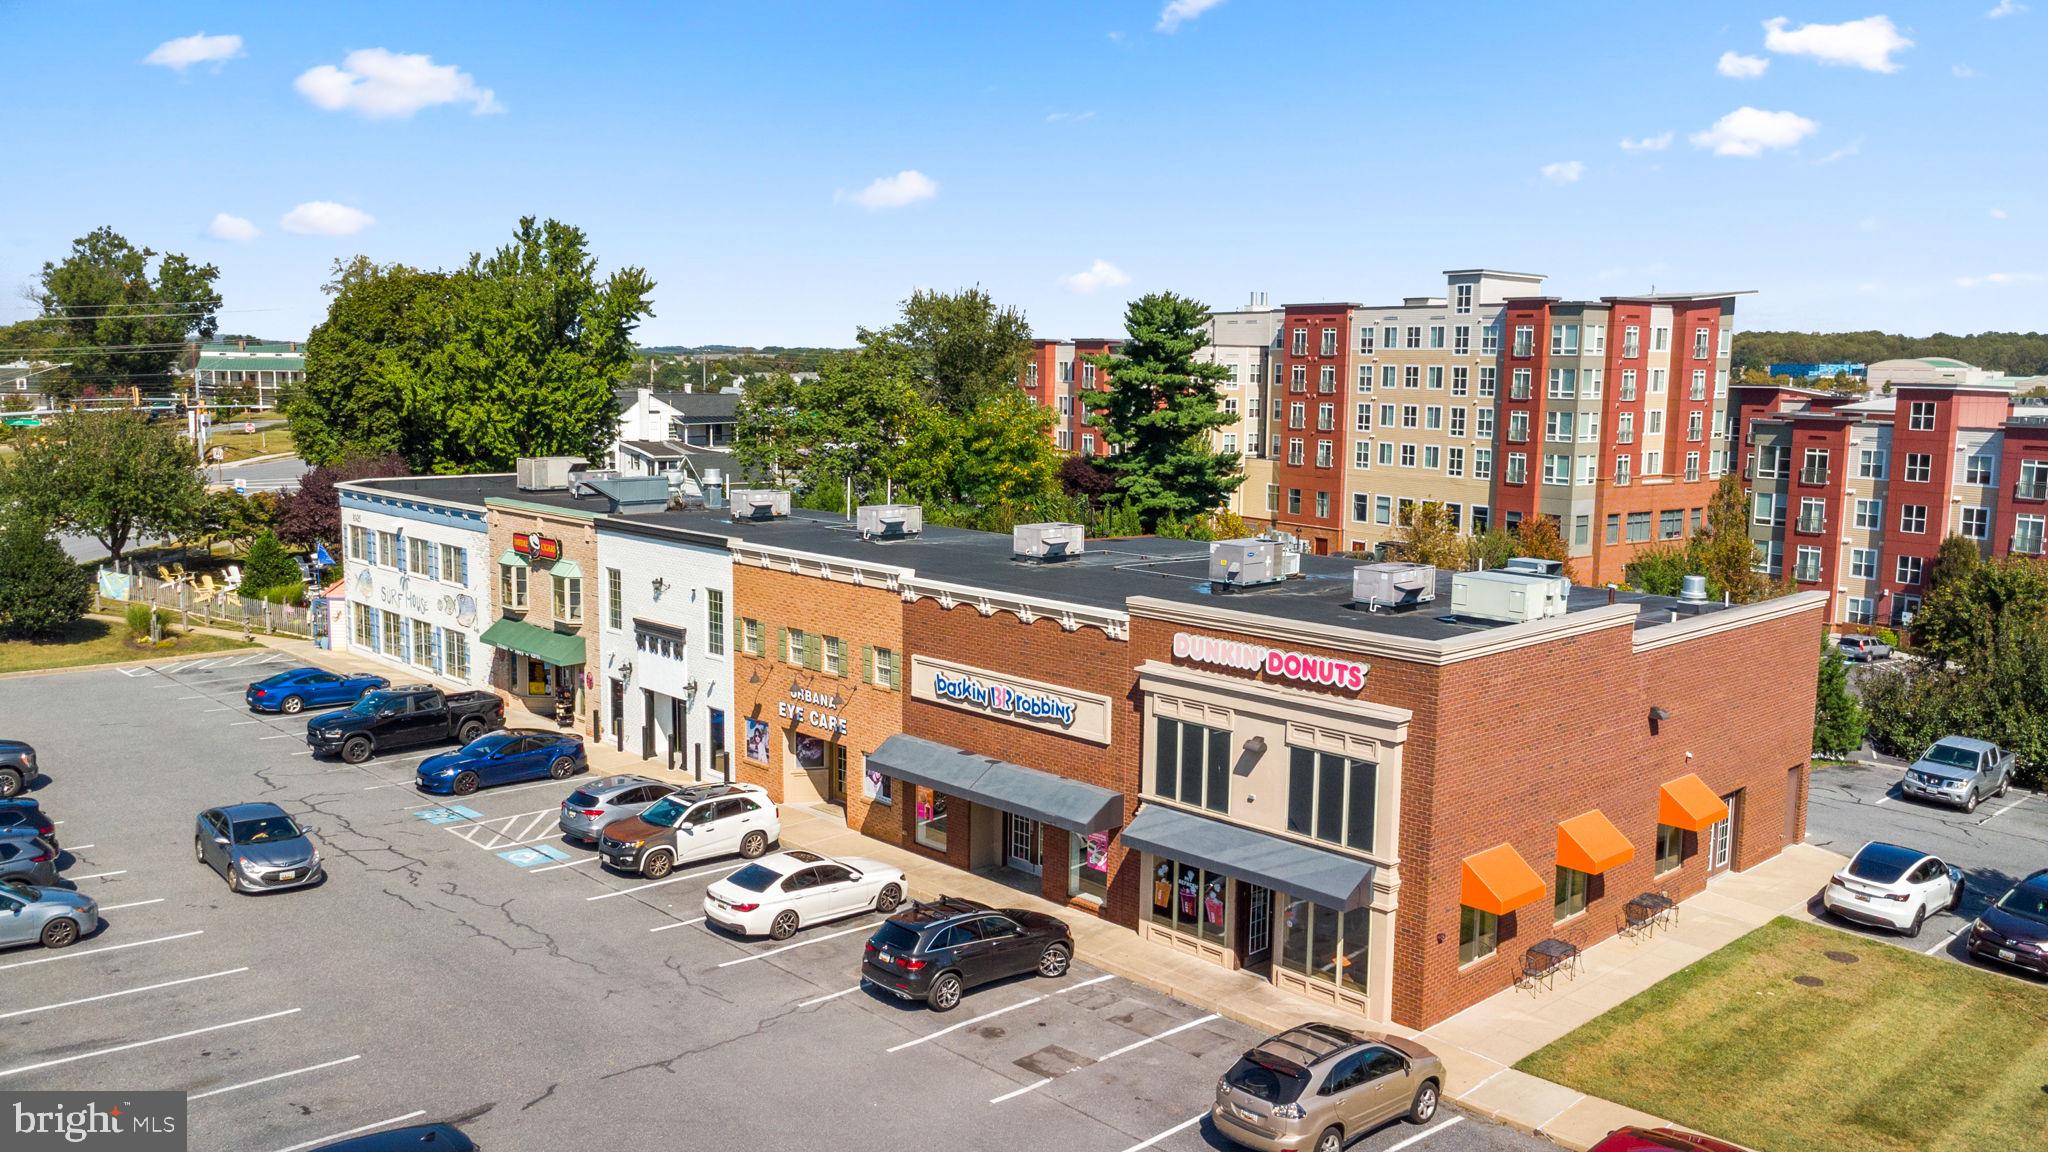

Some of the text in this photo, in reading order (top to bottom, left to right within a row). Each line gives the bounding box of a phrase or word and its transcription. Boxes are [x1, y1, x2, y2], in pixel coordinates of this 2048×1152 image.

[381, 586, 429, 614] SURF HOUSE
[1173, 632, 1365, 690] DUNKIN' DONUTS
[790, 688, 837, 710] URBANA
[935, 672, 988, 708] baskin
[1015, 692, 1074, 724] robbins
[779, 701, 848, 735] EYE CARE
